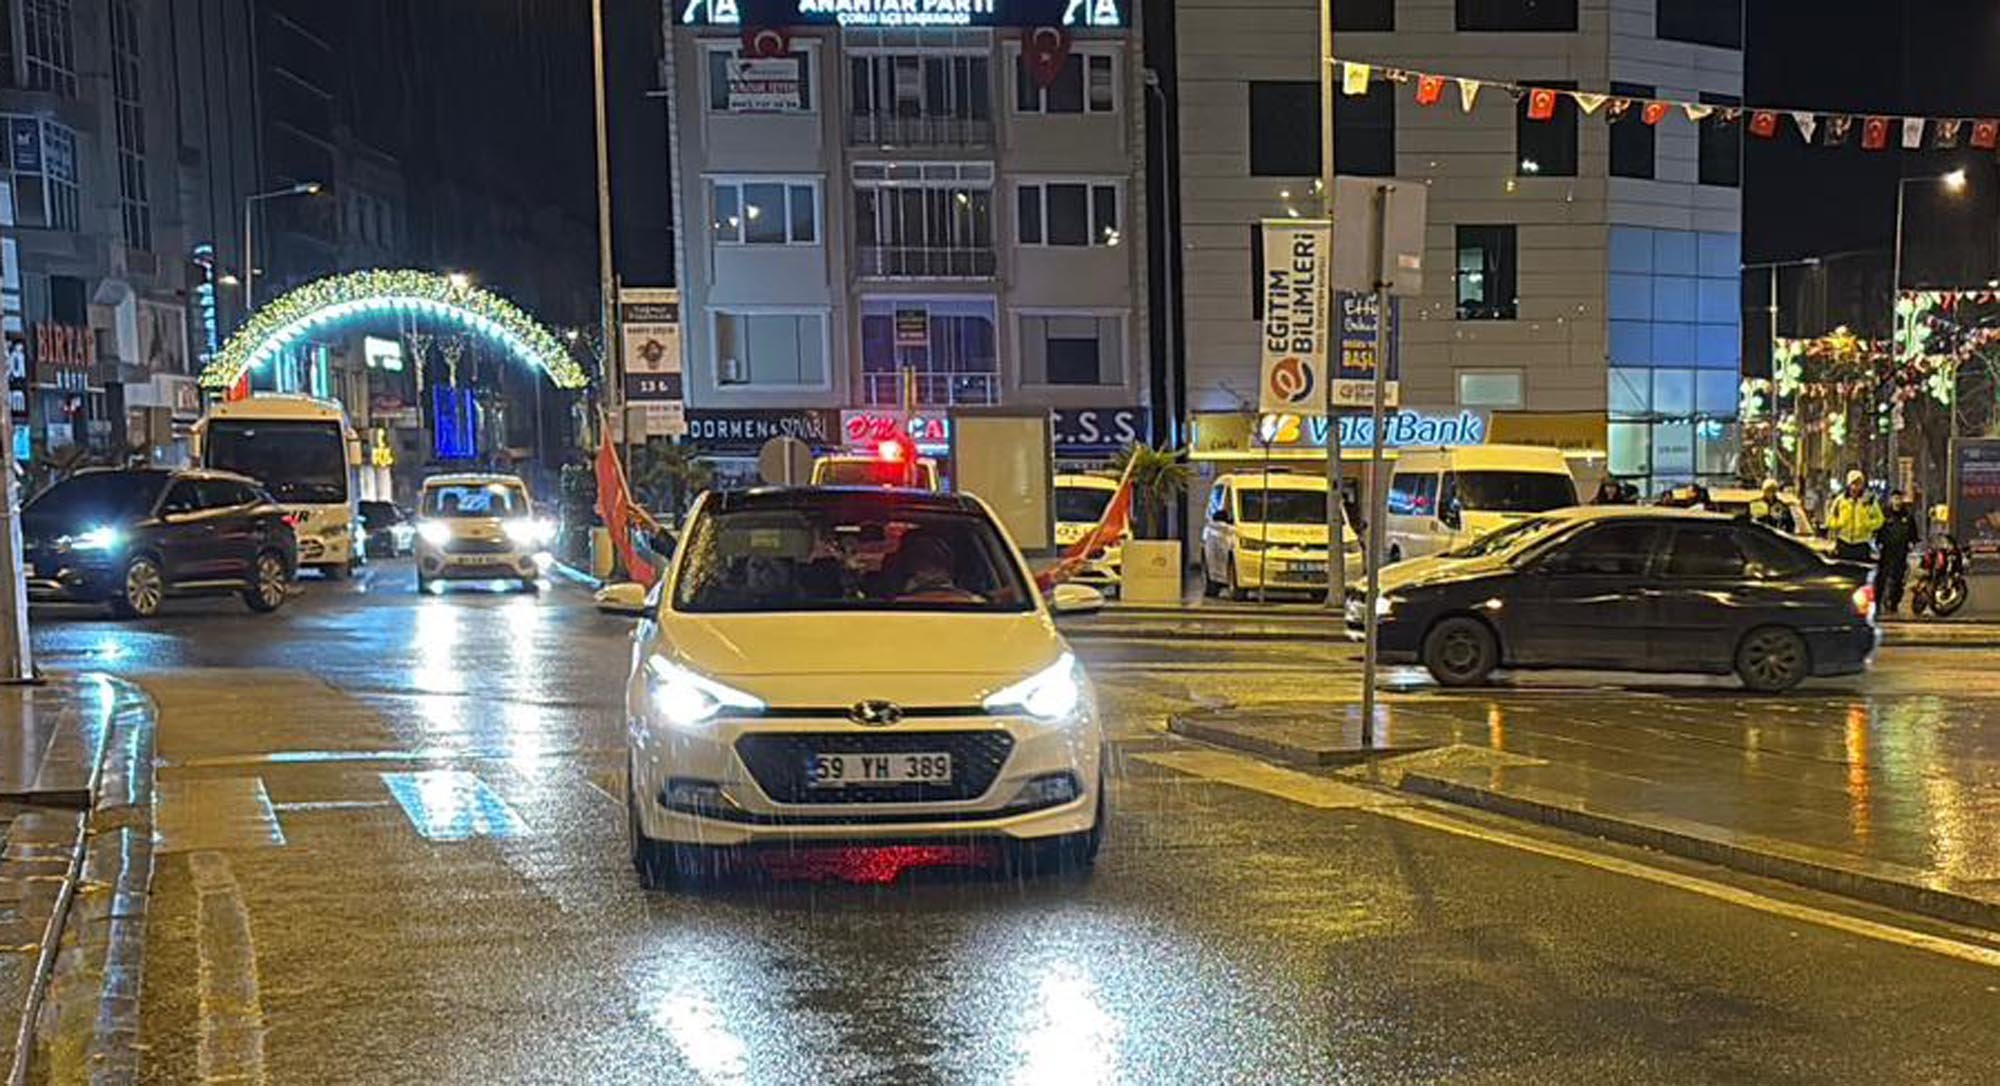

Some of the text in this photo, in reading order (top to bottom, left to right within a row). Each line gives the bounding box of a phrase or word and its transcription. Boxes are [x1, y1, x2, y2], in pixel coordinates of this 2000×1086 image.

[1267, 269, 1290, 354] EĞİTİM
[1292, 233, 1316, 354] BİLİMLERİ
[690, 420, 768, 439] DORMEN
[817, 756, 947, 779] 59 YH 389
